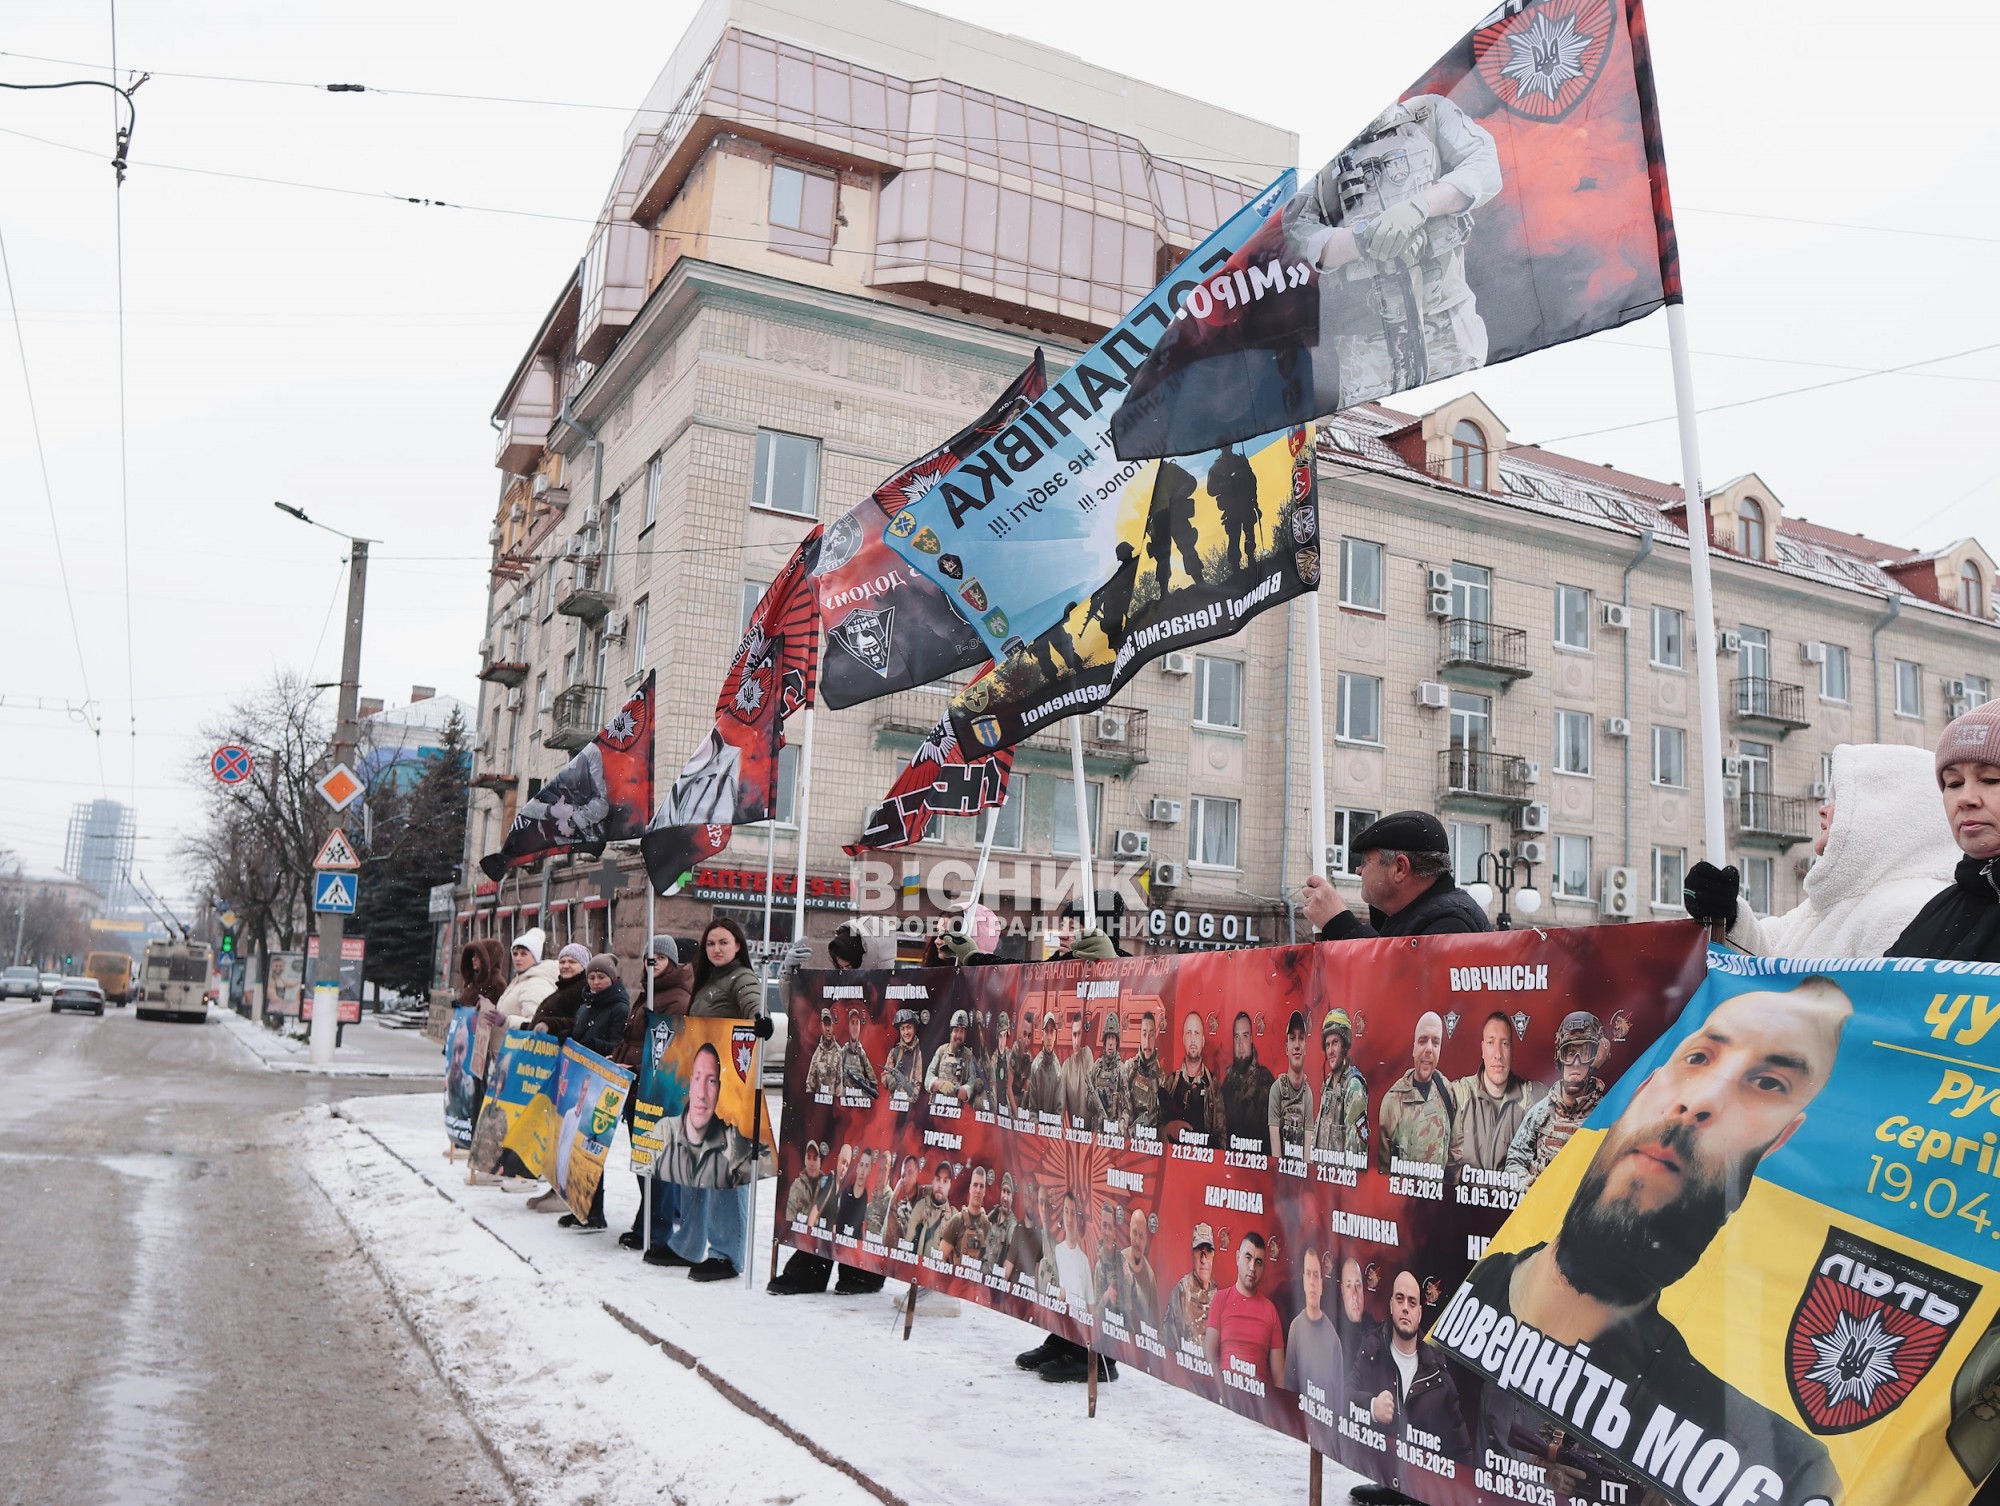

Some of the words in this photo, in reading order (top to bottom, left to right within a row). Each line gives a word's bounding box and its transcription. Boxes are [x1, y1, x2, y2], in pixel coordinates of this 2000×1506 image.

[697, 889, 745, 902] ГОЛОВНА
[792, 896, 824, 908] ТОГО
[1150, 909, 1260, 942] GOGOL
[1120, 957, 1171, 977] БРИГАДА
[1449, 964, 1549, 993] ВОВЧАНСЬК
[923, 1129, 962, 1150] ТОРЕЦЬК
[1130, 1138, 1163, 1157] 21.12.2023
[1178, 1128, 1210, 1148] Сократ
[1230, 1134, 1263, 1153] Сармат
[1171, 1144, 1214, 1164] 21.12.2023
[1224, 1151, 1268, 1171] 21.12.2023
[1345, 1146, 1368, 1170] Юрій
[1316, 1165, 1357, 1188] 21.12.2023
[1390, 1156, 1445, 1180] Пономарь
[1461, 1164, 1519, 1193] Сталкер
[1204, 1185, 1264, 1215] КАРЛІВКА
[1389, 1175, 1444, 1201] 15.05.2024
[1819, 1253, 1960, 1326] ЛЮТЬ
[1230, 1354, 1256, 1378] Оскар
[1222, 1369, 1265, 1399] 19.08.2024
[1350, 1400, 1371, 1426] Рука
[1338, 1415, 1387, 1453] 30.05.2025
[1406, 1423, 1441, 1452] Атлас
[1396, 1439, 1456, 1480] 30.05.2025
[1485, 1448, 1547, 1485] Студент
[1474, 1468, 1556, 1506] 06.08.2025
